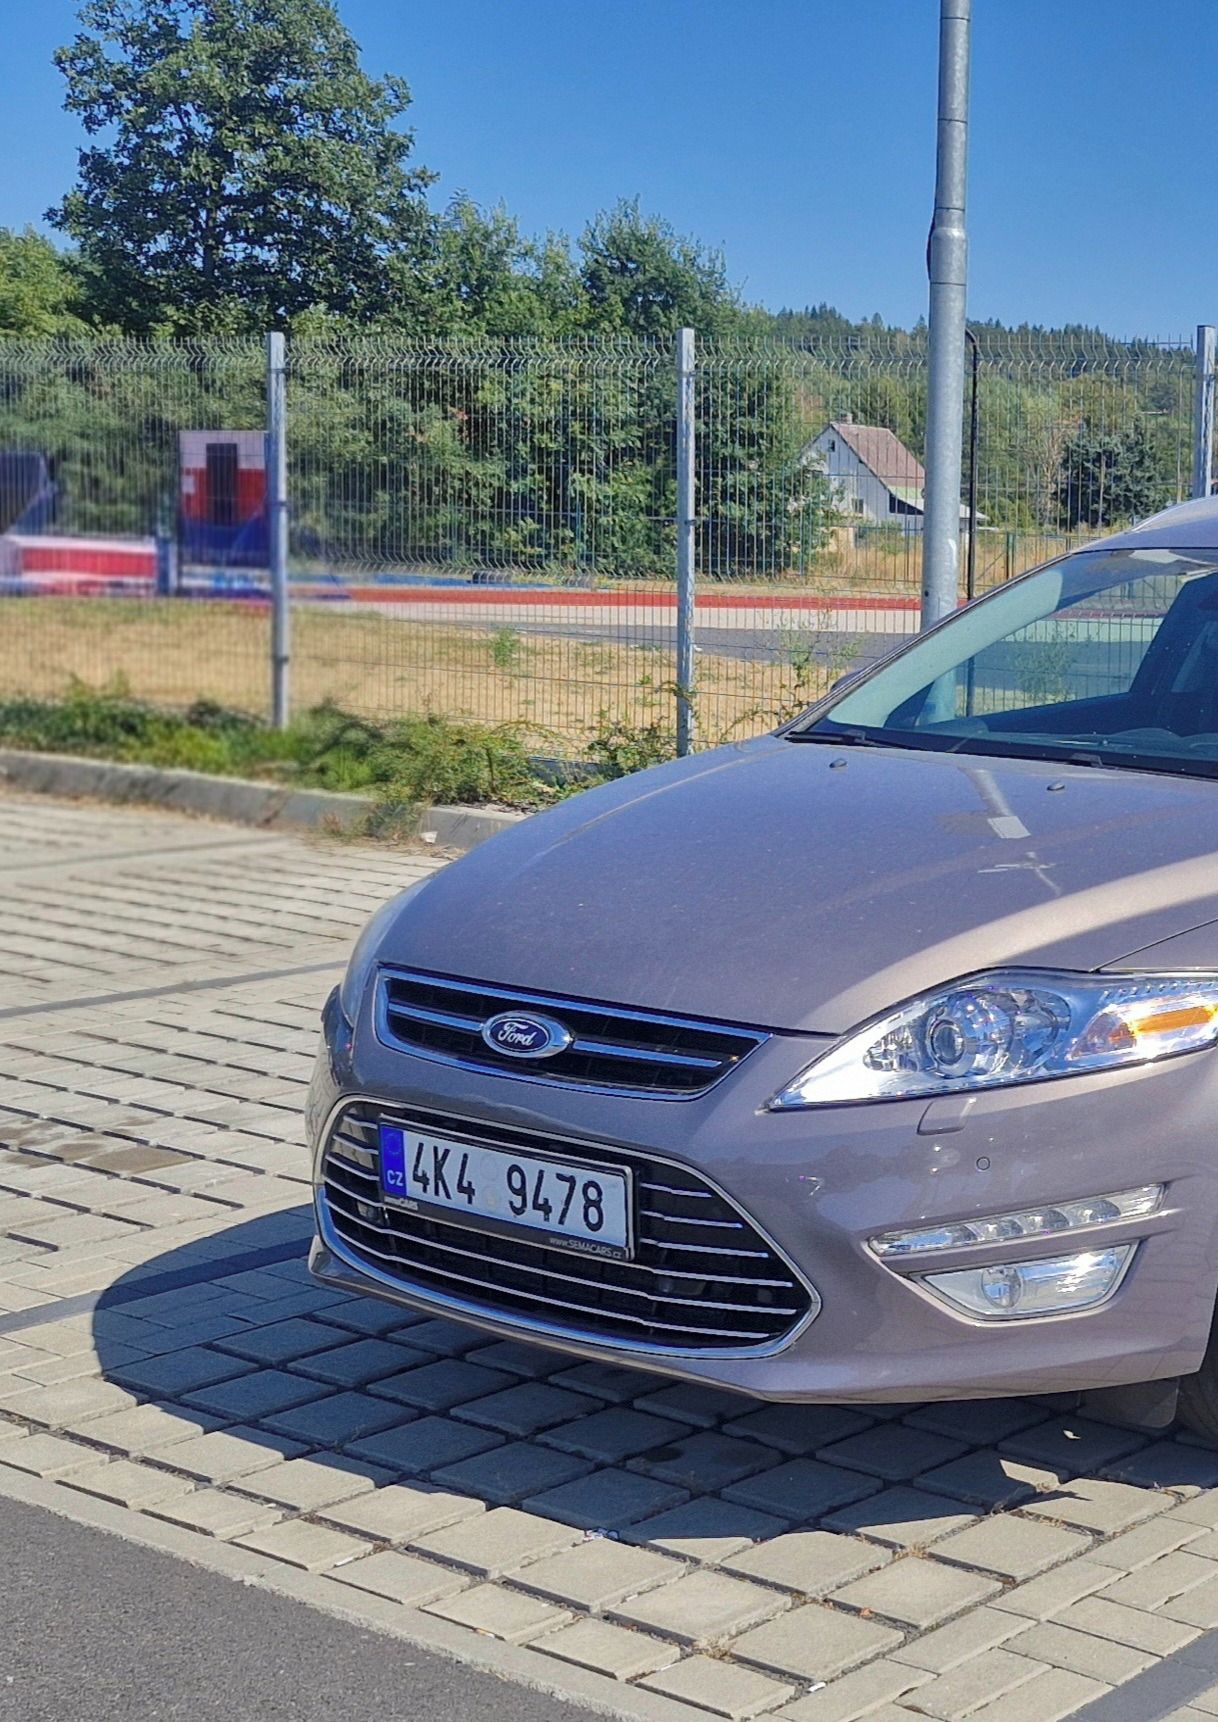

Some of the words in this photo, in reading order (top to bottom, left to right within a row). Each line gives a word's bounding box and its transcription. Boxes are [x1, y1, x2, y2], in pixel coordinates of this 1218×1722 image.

[497, 1022, 537, 1046] Ford
[387, 1170, 404, 1187] CZ
[412, 1142, 476, 1205] 4K4
[506, 1164, 604, 1232] 9478
